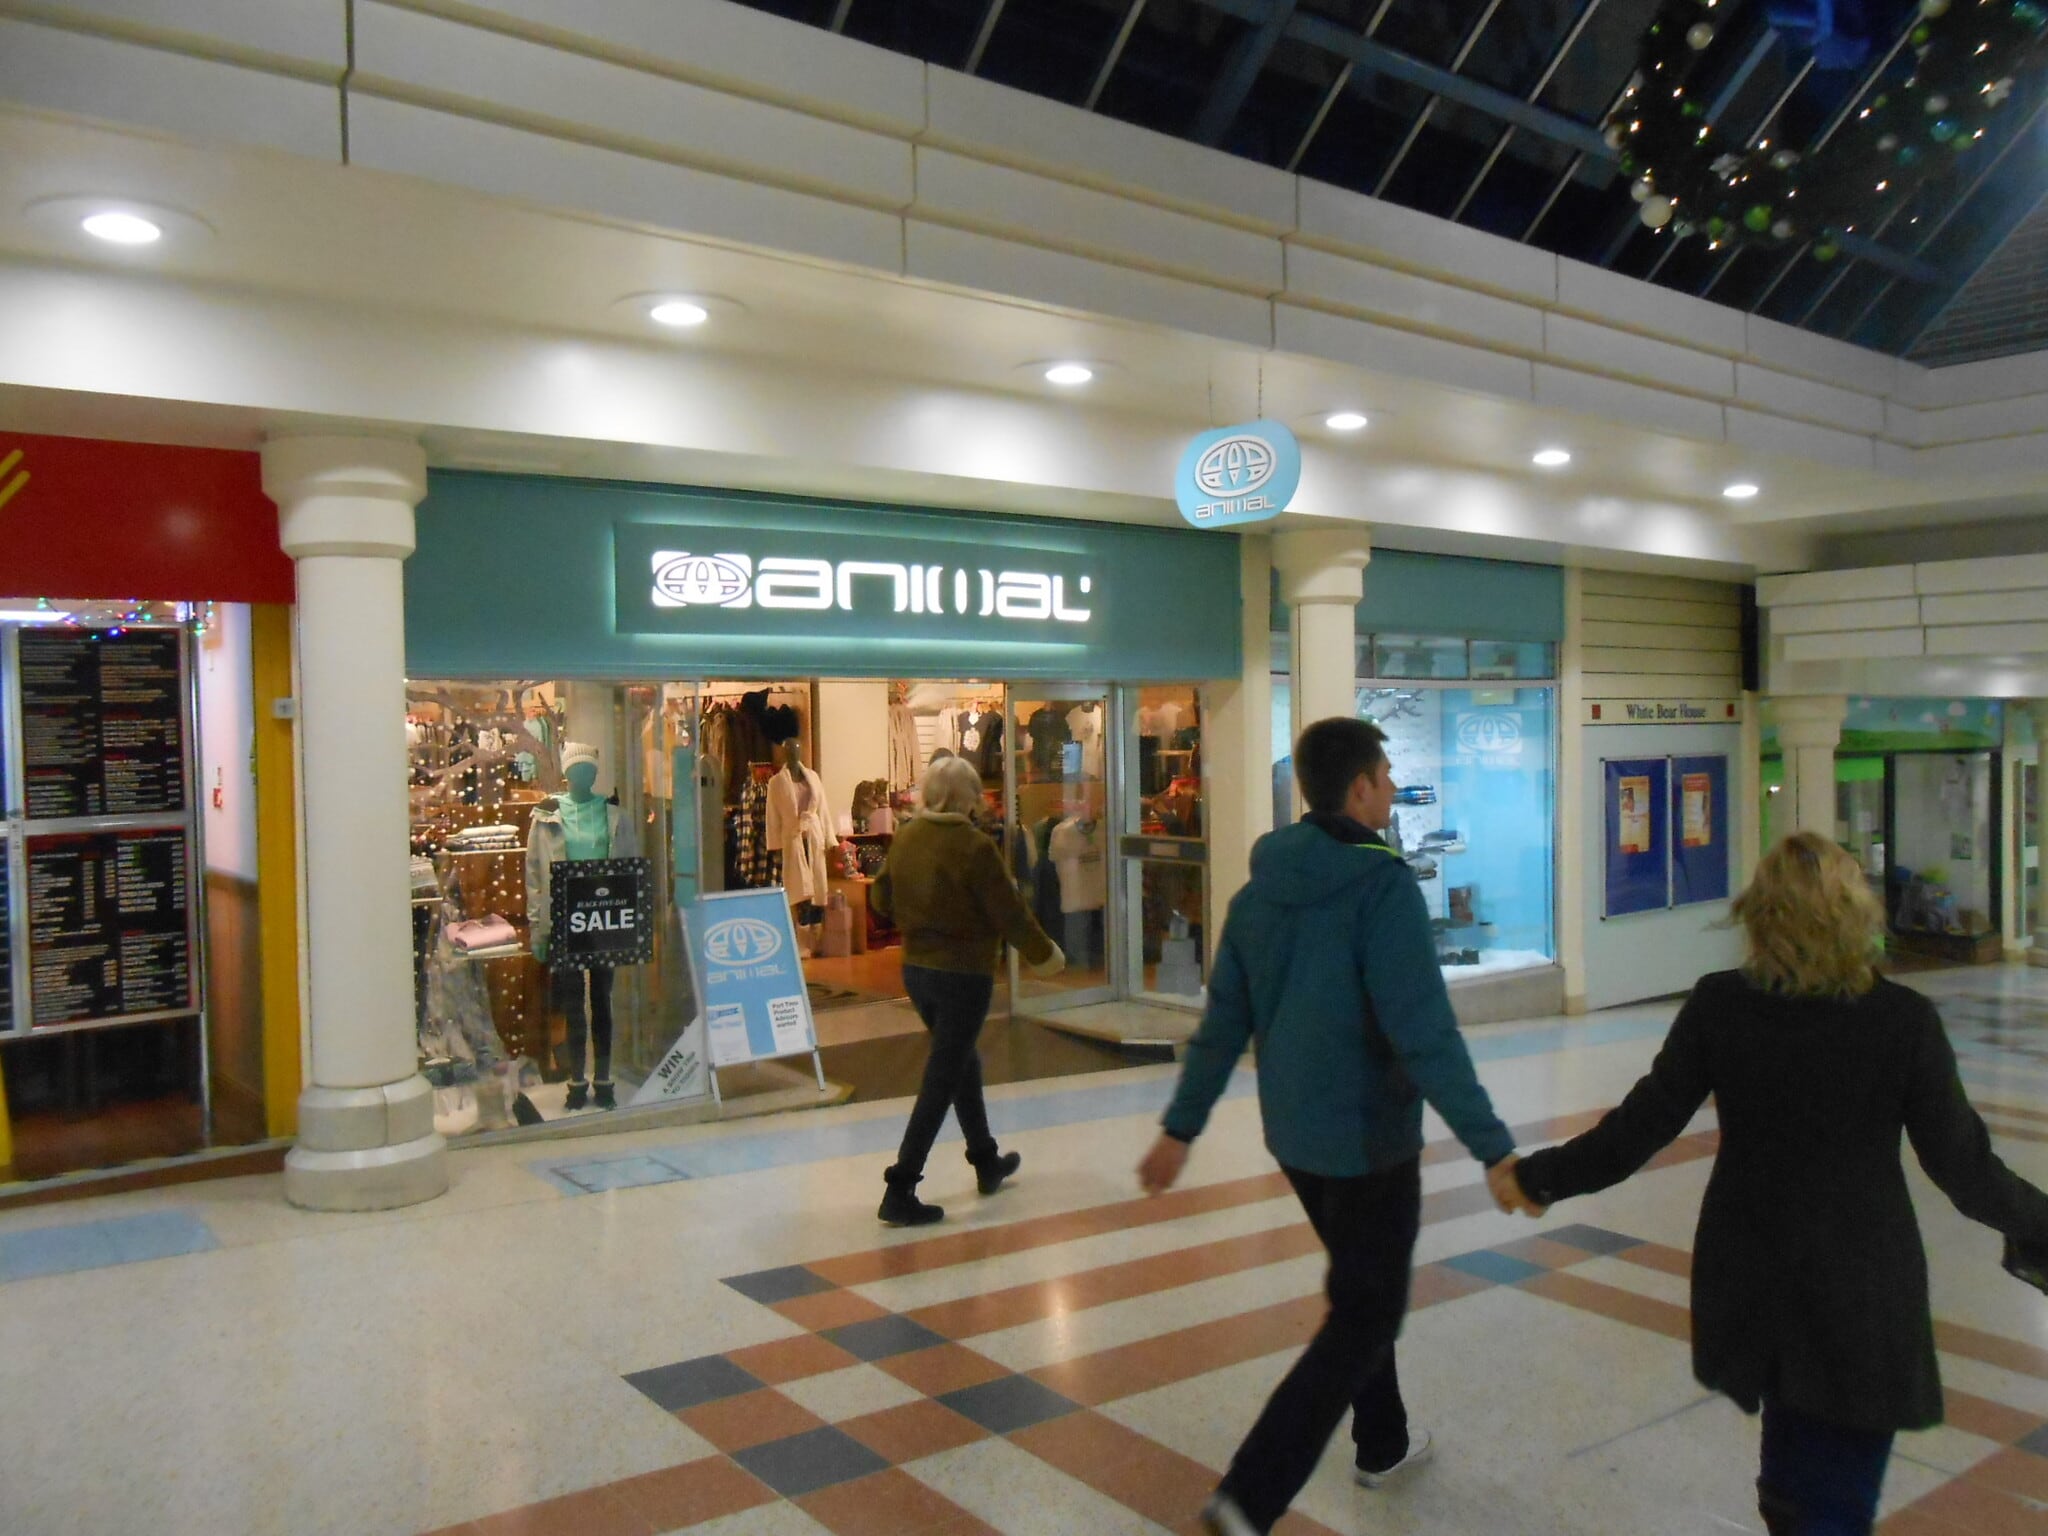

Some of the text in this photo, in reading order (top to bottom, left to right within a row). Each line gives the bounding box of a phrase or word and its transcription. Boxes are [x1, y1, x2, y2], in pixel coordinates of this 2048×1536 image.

[1626, 703, 1654, 719] White
[1657, 703, 1677, 718] Bear
[570, 908, 635, 933] SALE
[658, 1050, 684, 1078] WIN
